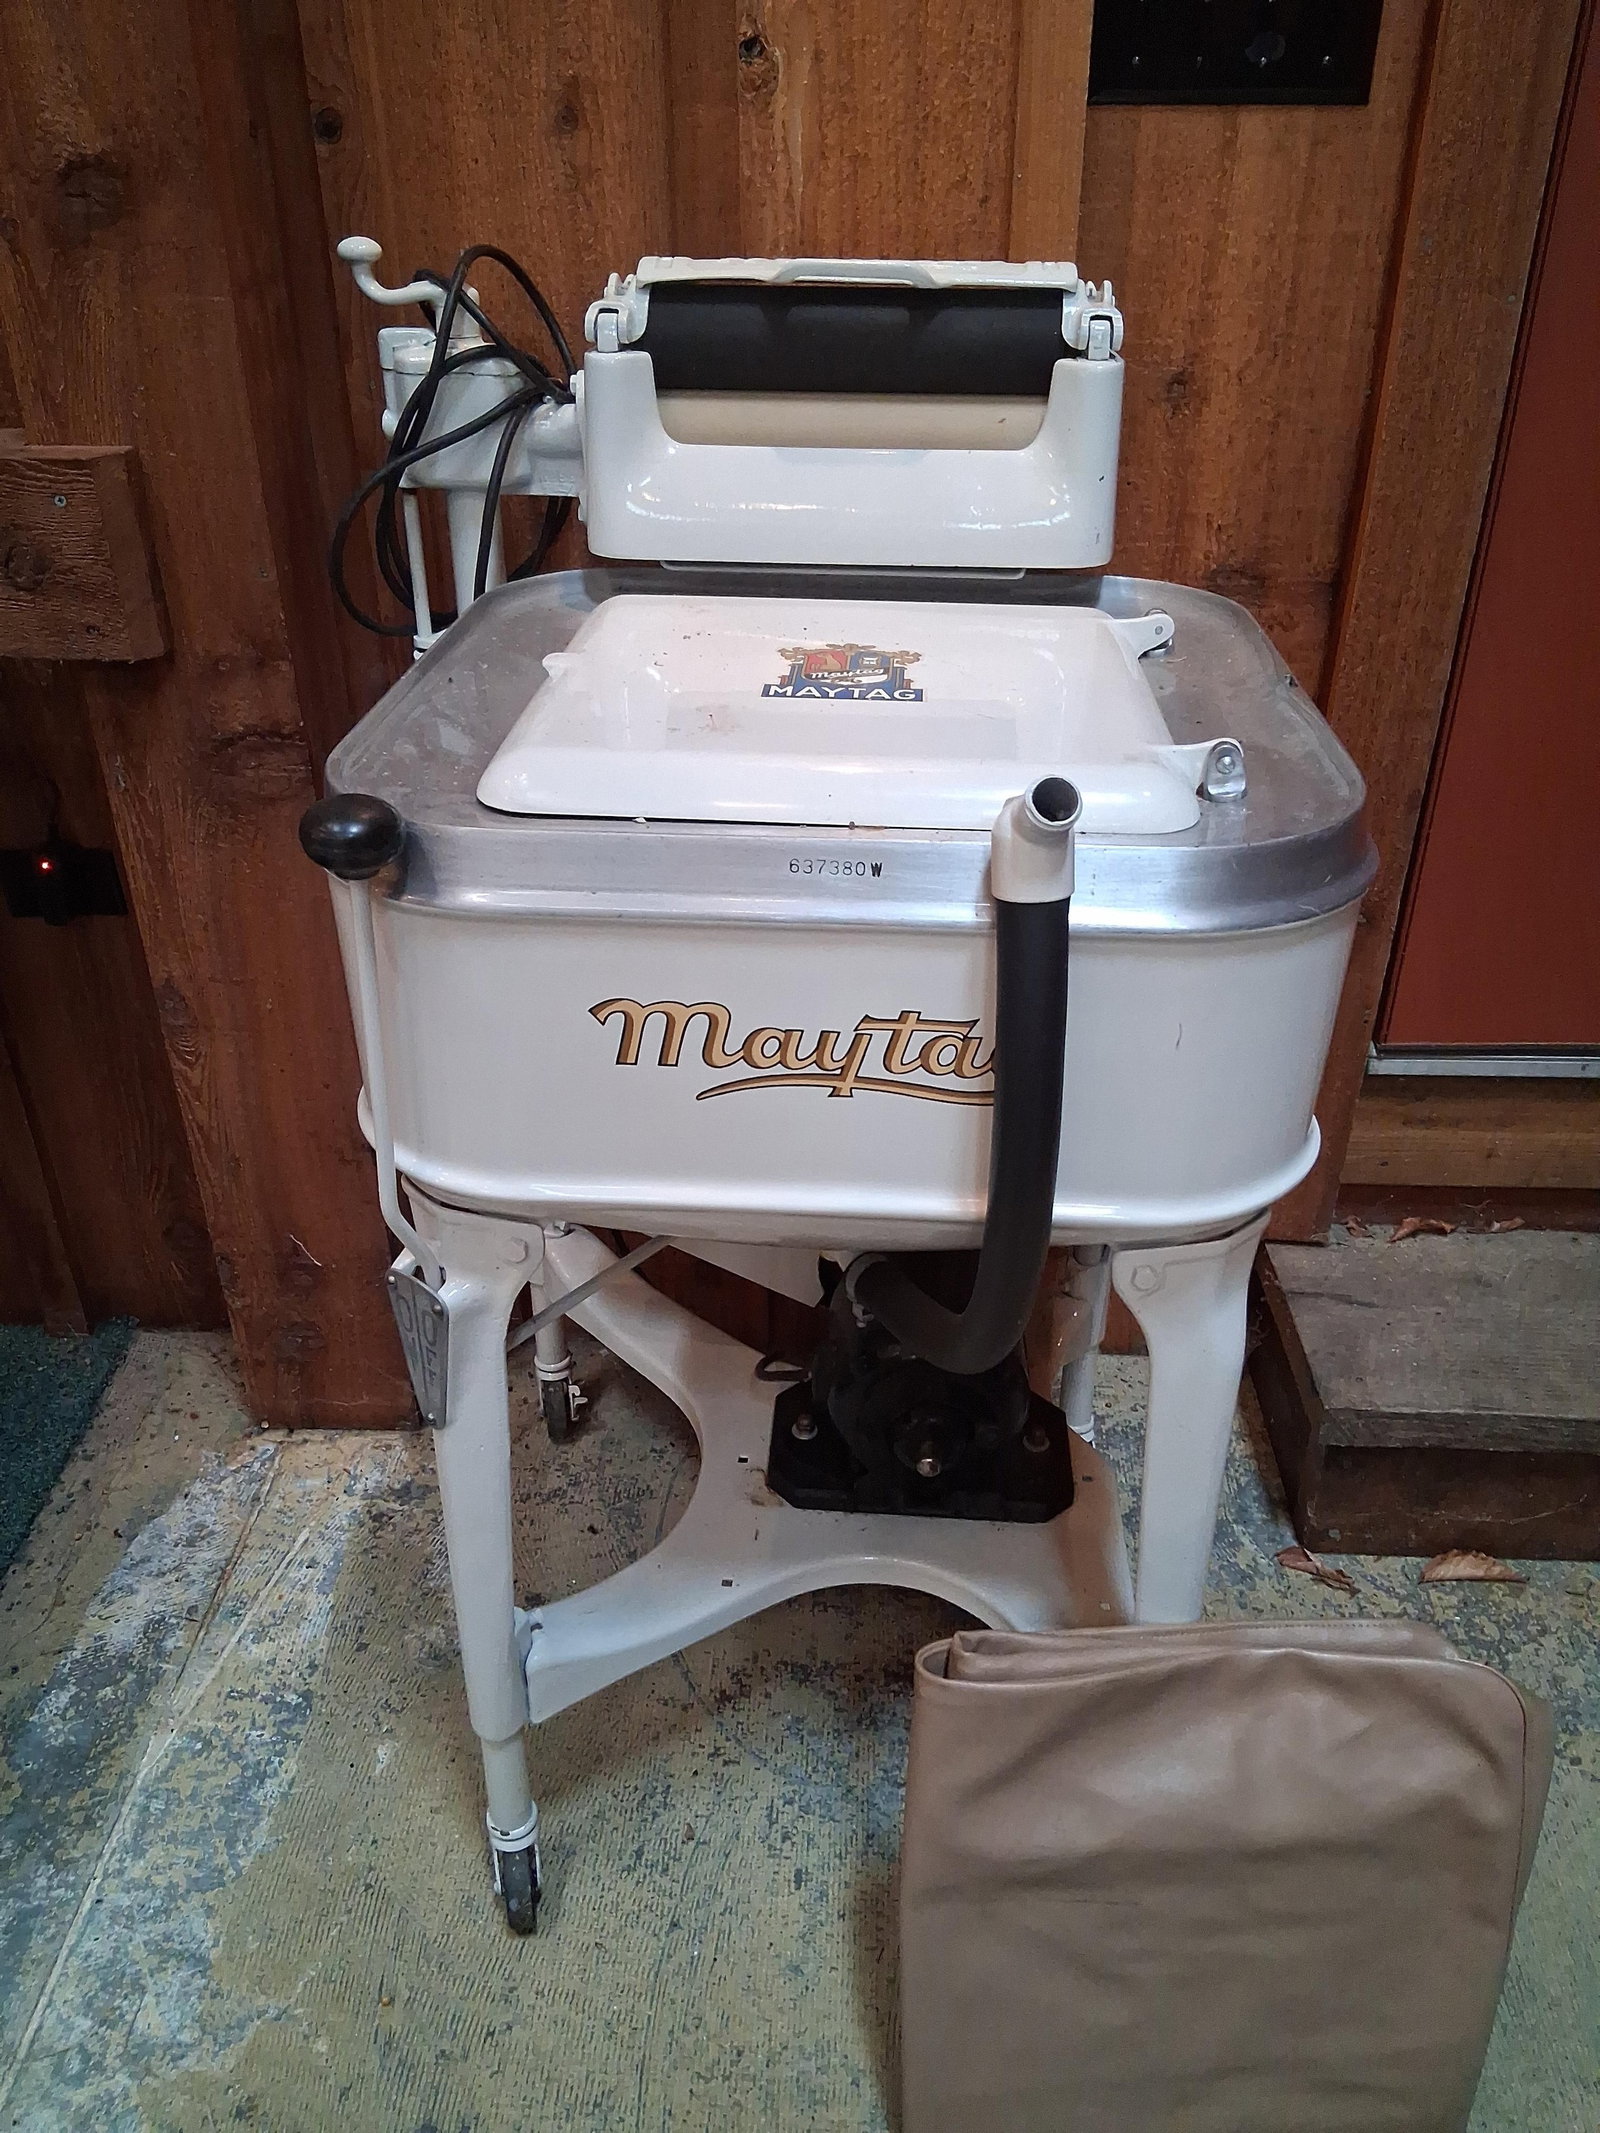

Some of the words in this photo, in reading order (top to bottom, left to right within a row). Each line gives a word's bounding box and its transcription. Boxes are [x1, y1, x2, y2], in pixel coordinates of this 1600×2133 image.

[768, 685, 917, 700] MAYTAG
[788, 858, 883, 878] 637380W
[588, 998, 996, 1099] Mayta
